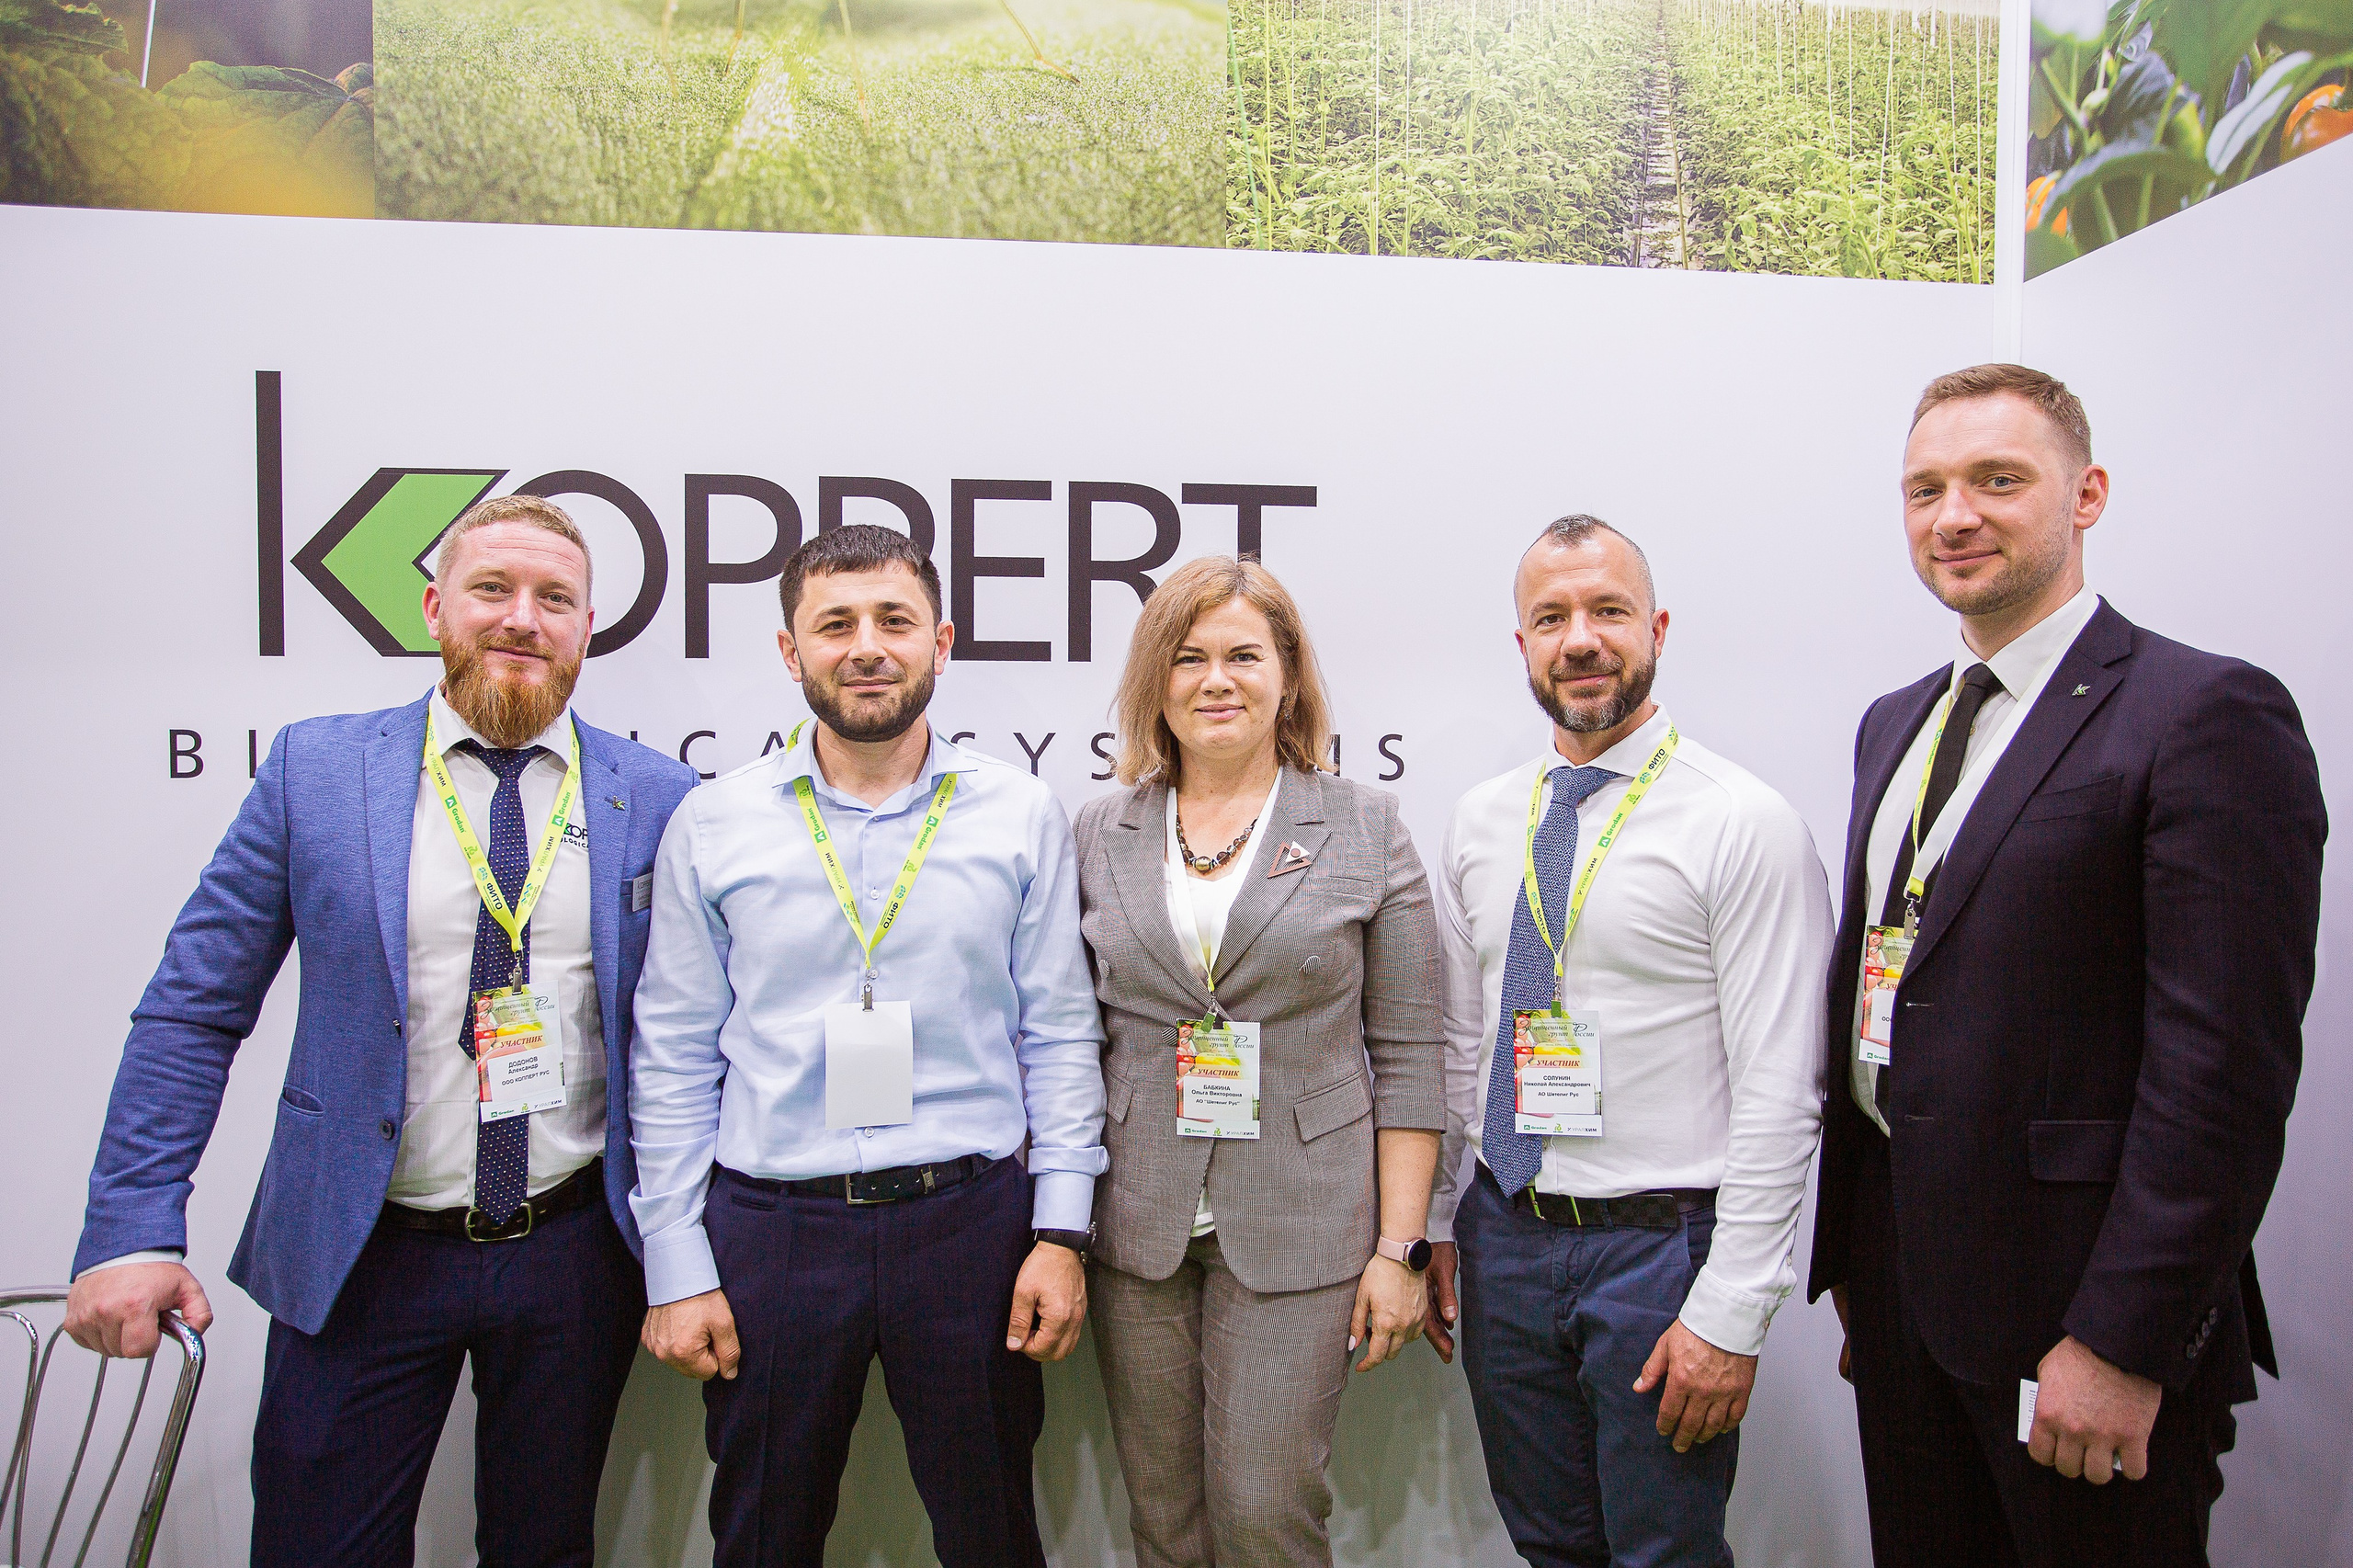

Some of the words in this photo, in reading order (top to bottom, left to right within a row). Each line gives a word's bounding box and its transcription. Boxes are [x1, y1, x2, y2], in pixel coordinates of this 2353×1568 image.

[1648, 747, 1666, 771] ФИТО
[557, 790, 572, 816] Grodan
[451, 808, 467, 834] Grodan
[807, 807, 820, 832] Grodan
[1606, 812, 1624, 836] Grodan
[916, 826, 932, 851] Grodan
[486, 882, 504, 911] ФИТО
[883, 902, 900, 929] ФИТО
[500, 1034, 543, 1049] УЧАСТНИК
[508, 1056, 539, 1068] ДОДОНОВ
[508, 1062, 539, 1074] Александр
[1197, 1068, 1240, 1077] УЧАСТНИК
[515, 1072, 539, 1083] КОППЕРТ
[540, 1069, 551, 1078] РУС
